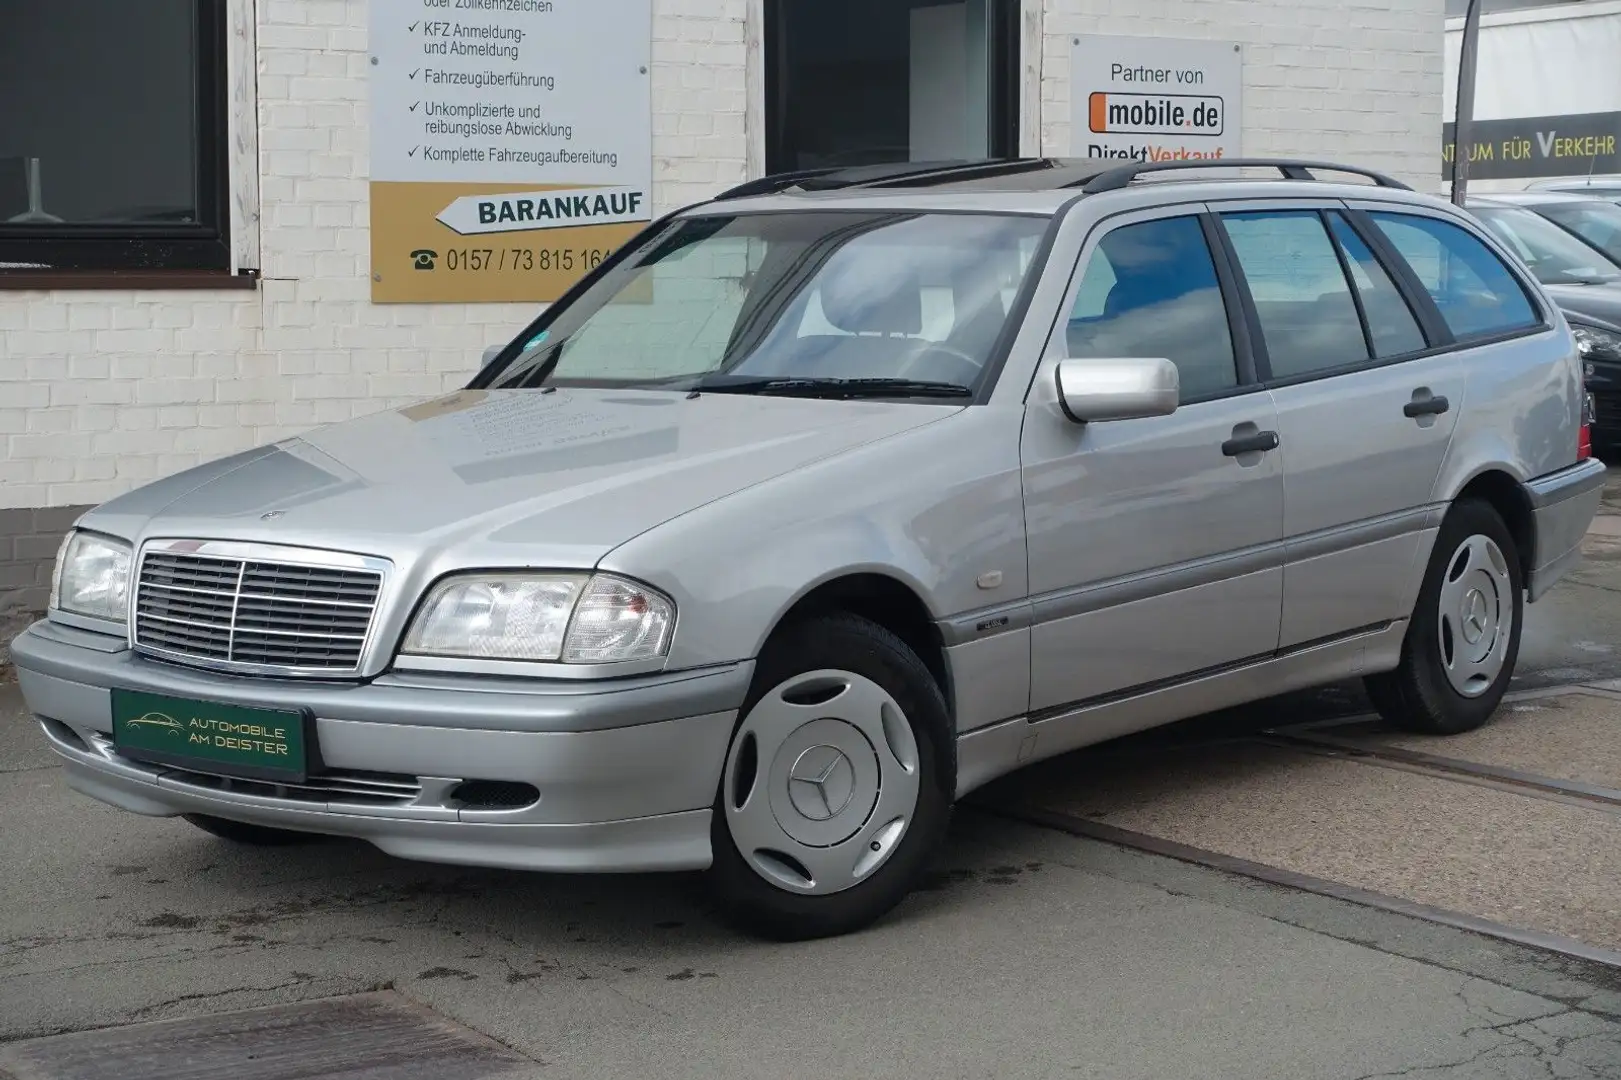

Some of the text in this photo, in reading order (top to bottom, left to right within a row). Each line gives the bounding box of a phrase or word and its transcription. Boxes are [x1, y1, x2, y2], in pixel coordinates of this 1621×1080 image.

[424, 22, 526, 43] KFZ Anmeldung-
[424, 41, 519, 61] und Abmeldung
[424, 69, 555, 90] Fahrzeugüberführung
[1111, 63, 1204, 84] Partner von
[425, 102, 541, 120] Unkomplizierte und
[1109, 100, 1218, 127] mobile.de
[425, 120, 572, 140] reibungslose Abwicklung
[424, 146, 618, 167] Komplette Fahrzeugaufbereitung
[1441, 131, 1616, 162] NTUM FÜR VERKEHR
[478, 192, 643, 224] BARANKAUF
[447, 249, 492, 270] 0157
[499, 249, 506, 270] /
[511, 249, 533, 270] 73
[540, 249, 573, 270] 815
[189, 718, 286, 739] AUTOMOBILE
[189, 733, 288, 755] AM DEISTER
